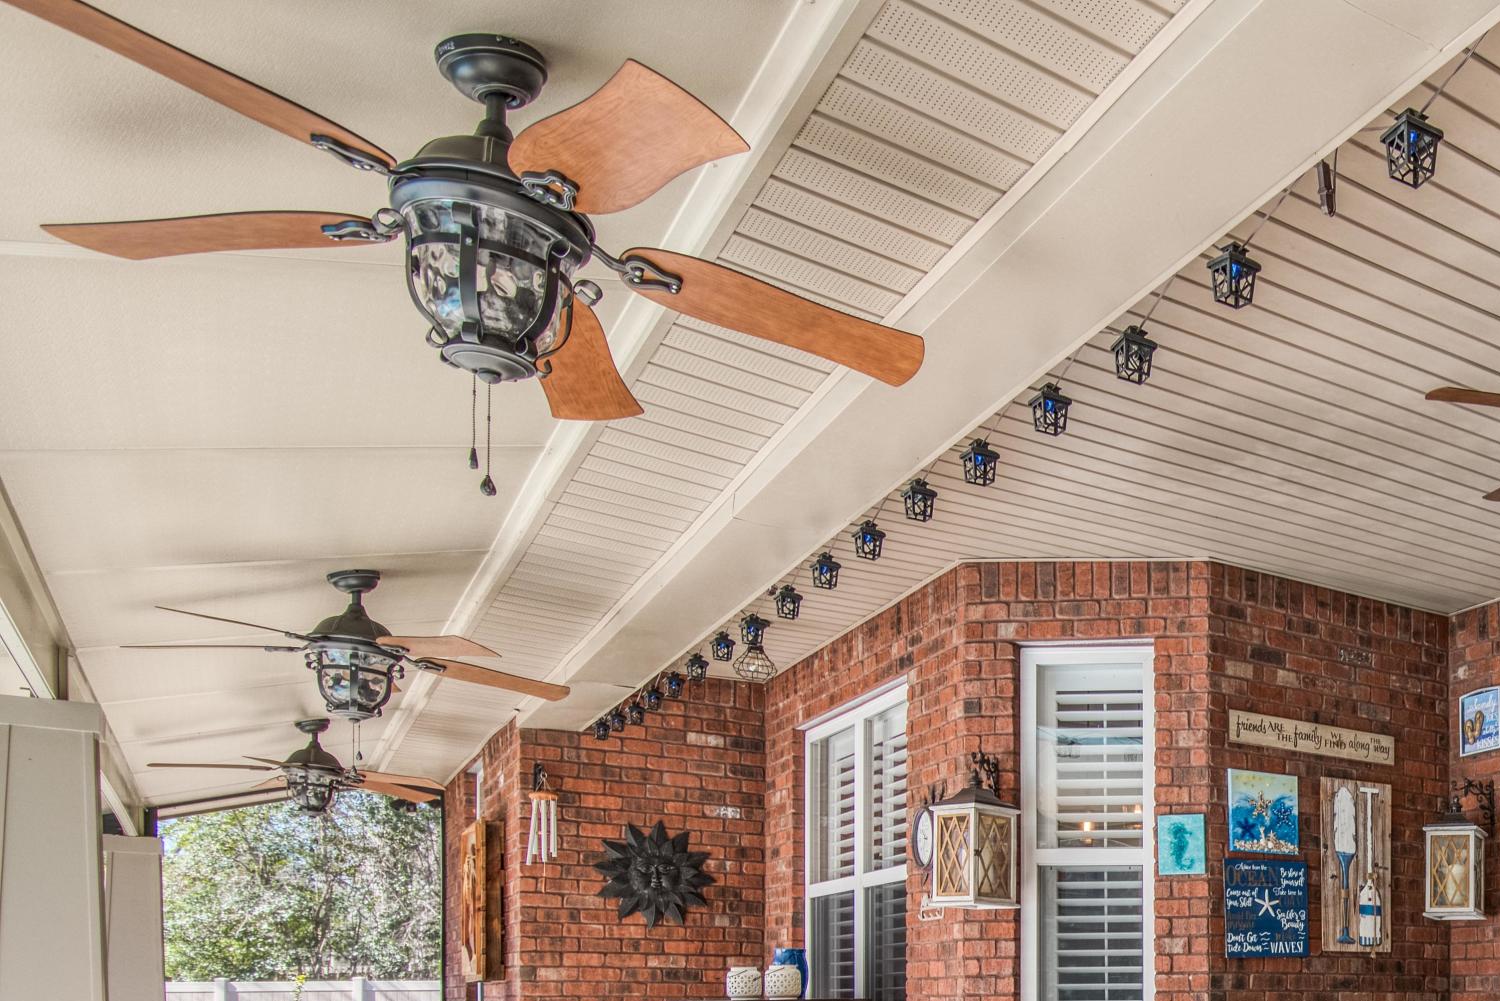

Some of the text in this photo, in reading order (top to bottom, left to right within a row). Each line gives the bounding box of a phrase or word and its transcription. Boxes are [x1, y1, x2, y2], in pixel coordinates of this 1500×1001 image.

[1236, 714, 1267, 739] friends
[1268, 721, 1285, 733] ARE
[1277, 733, 1293, 743] THE
[1293, 724, 1322, 750] family
[1324, 738, 1347, 750] FIND
[1348, 732, 1370, 759] along
[1373, 744, 1391, 761] way
